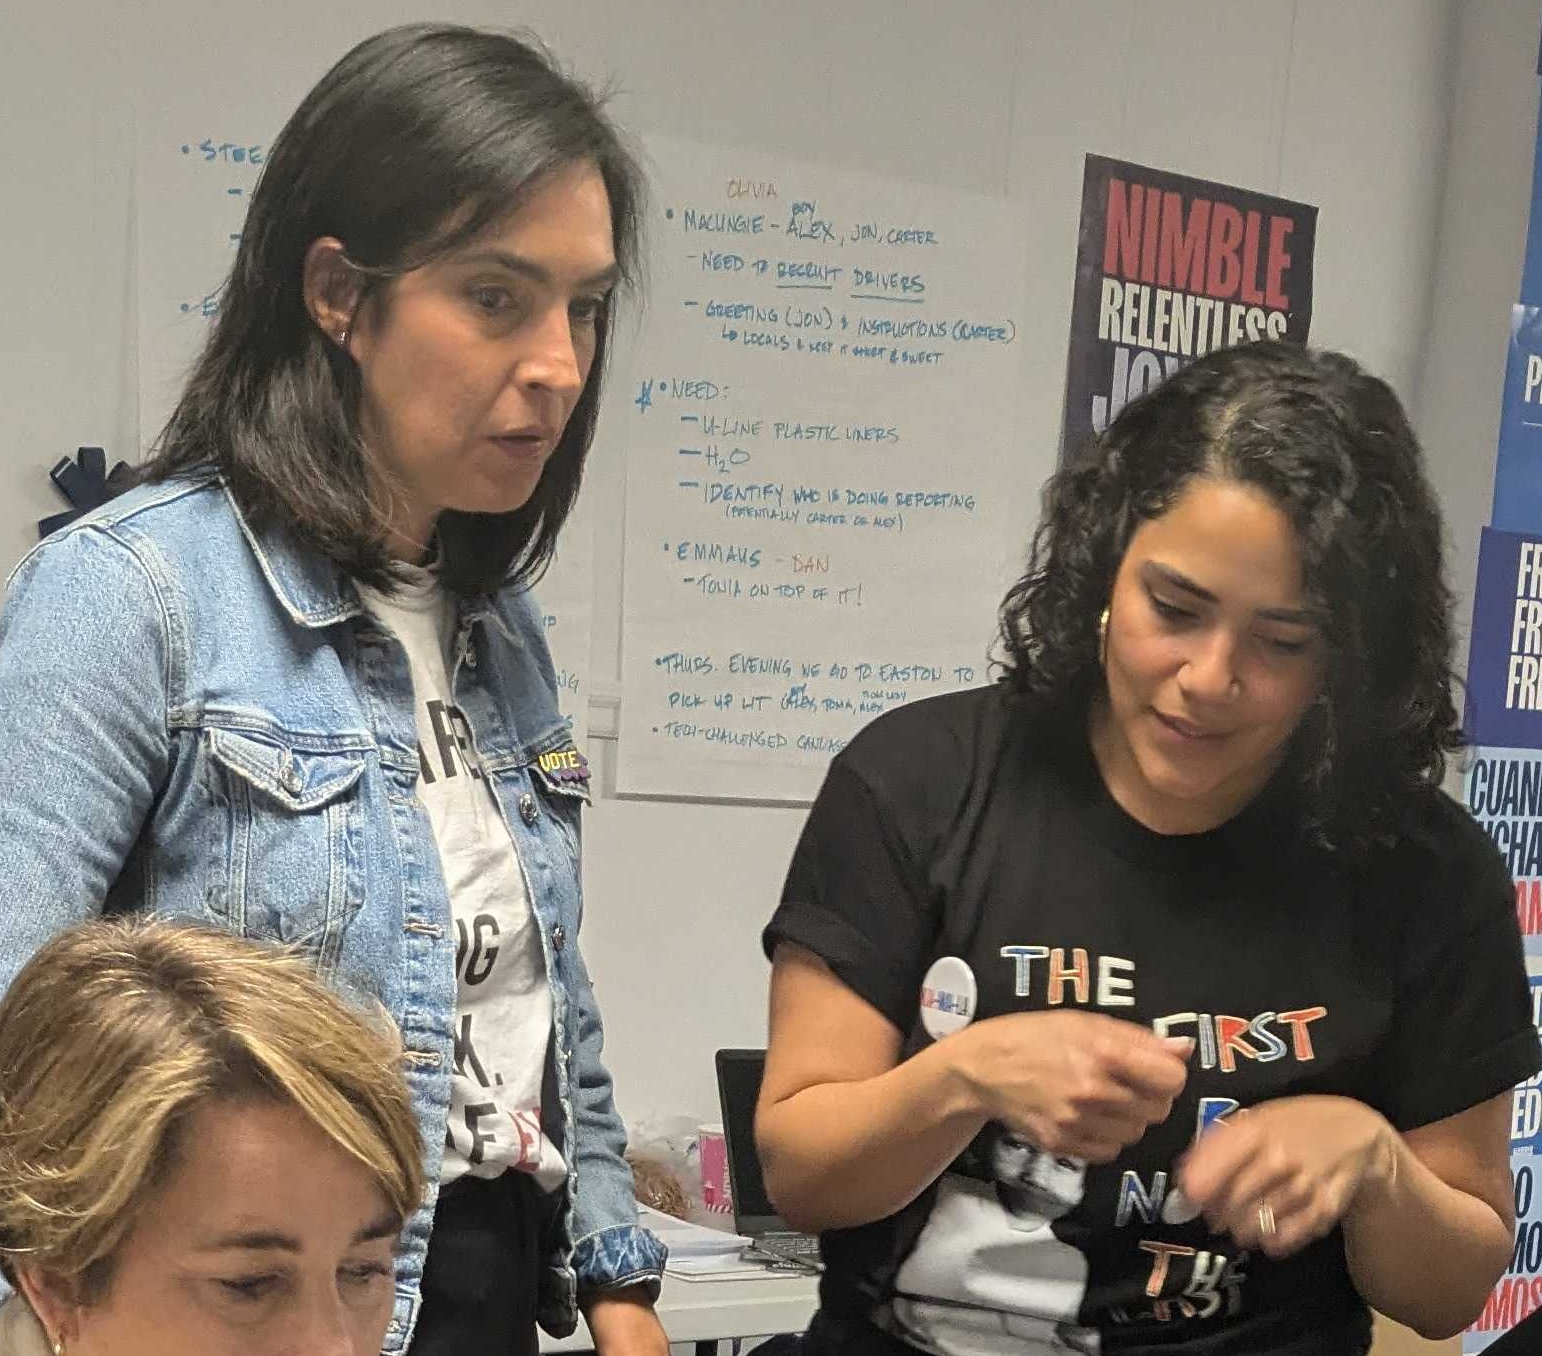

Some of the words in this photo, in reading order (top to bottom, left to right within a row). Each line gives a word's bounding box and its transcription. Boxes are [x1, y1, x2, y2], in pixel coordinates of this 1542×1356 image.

[1104, 178, 1293, 310] NIMBLE
[702, 251, 745, 271] NEED
[853, 267, 925, 293] DRIVERS
[774, 423, 841, 442] PLASTIC
[705, 483, 784, 507] IDENTIFY
[846, 489, 888, 506] DOING
[677, 542, 761, 568] EMMAUS
[774, 586, 804, 599] TOP
[729, 653, 791, 677] EVENING
[880, 664, 941, 682] EASTON
[955, 667, 974, 683] TO
[668, 691, 707, 708] PICK
[538, 750, 580, 772] VOTE
[1000, 945, 1136, 1007] THE
[1153, 1006, 1327, 1072] FIRST
